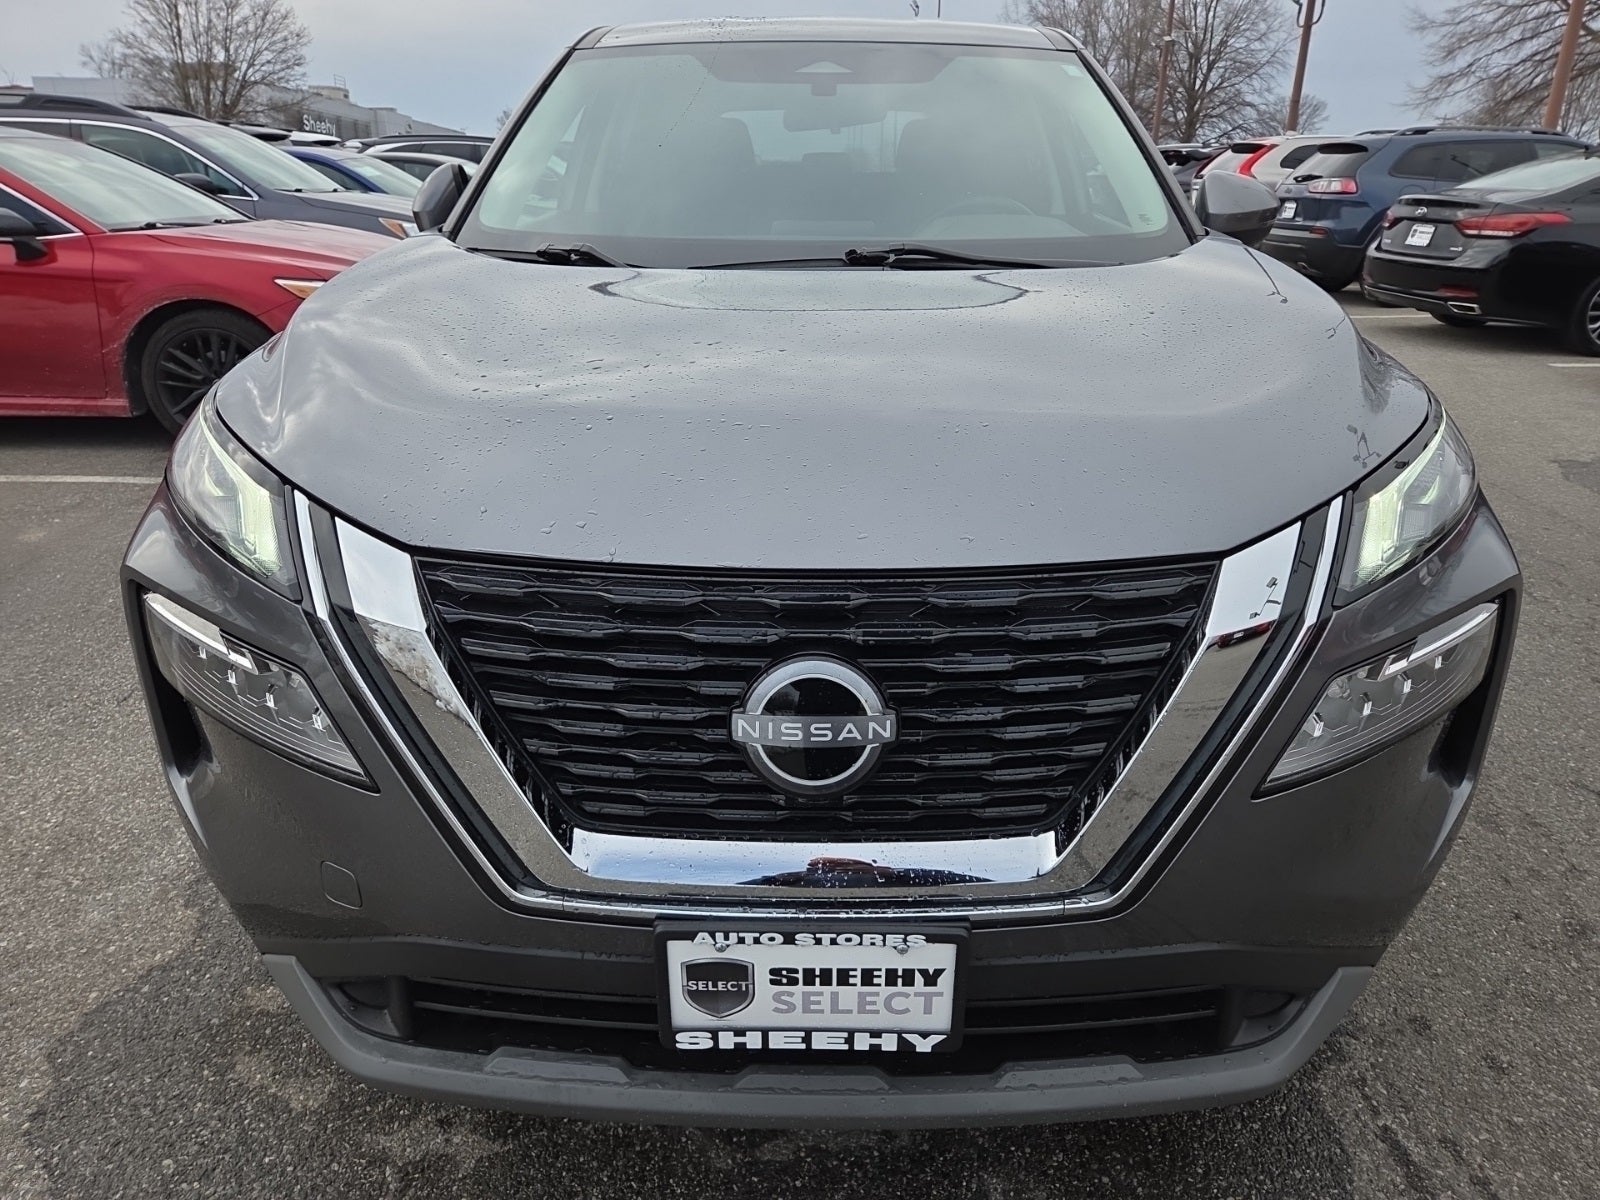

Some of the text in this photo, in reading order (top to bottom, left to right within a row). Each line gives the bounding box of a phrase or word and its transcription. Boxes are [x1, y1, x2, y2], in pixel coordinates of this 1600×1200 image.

[303, 114, 336, 137] Sheehy
[737, 719, 891, 742] NISSAN
[693, 932, 927, 947] AUTO STORES
[687, 980, 748, 992] SELECT
[768, 967, 947, 987] SHEEHY
[771, 991, 944, 1015] SELECT
[675, 1031, 947, 1053] SHEEHY
